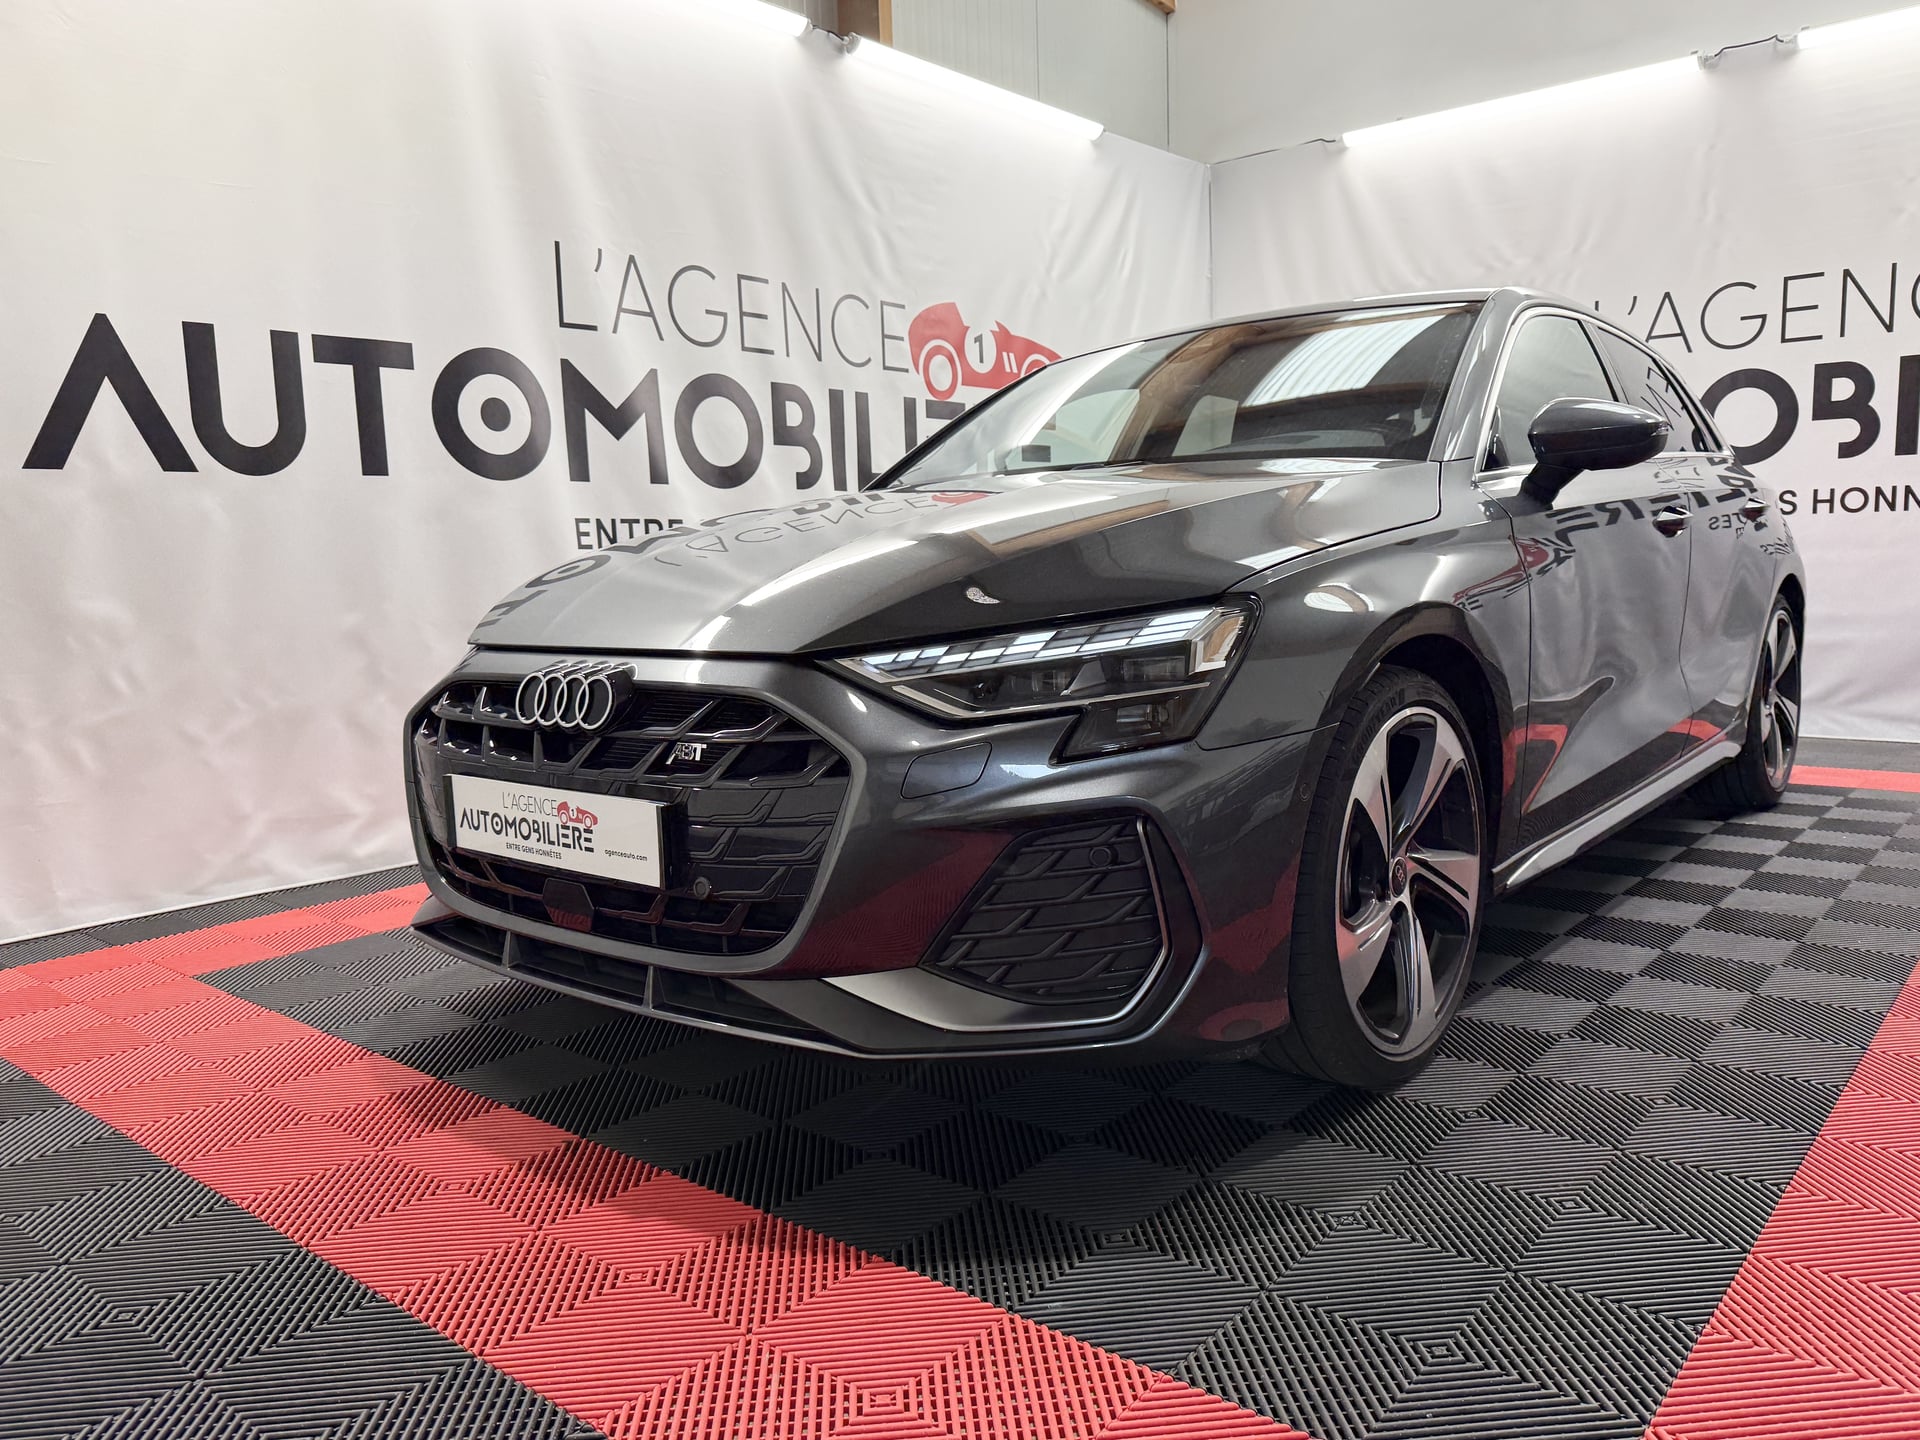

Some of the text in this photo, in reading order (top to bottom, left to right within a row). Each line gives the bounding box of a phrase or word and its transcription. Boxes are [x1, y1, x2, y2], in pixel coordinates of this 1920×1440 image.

[554, 240, 910, 373] L'AGENCE
[1594, 261, 1920, 353] 'AGEN
[974, 333, 985, 364] 1
[575, 517, 684, 550] ENT
[502, 792, 558, 817] L'AGENCE
[505, 842, 521, 852] ENTRE
[521, 844, 535, 855] GENS
